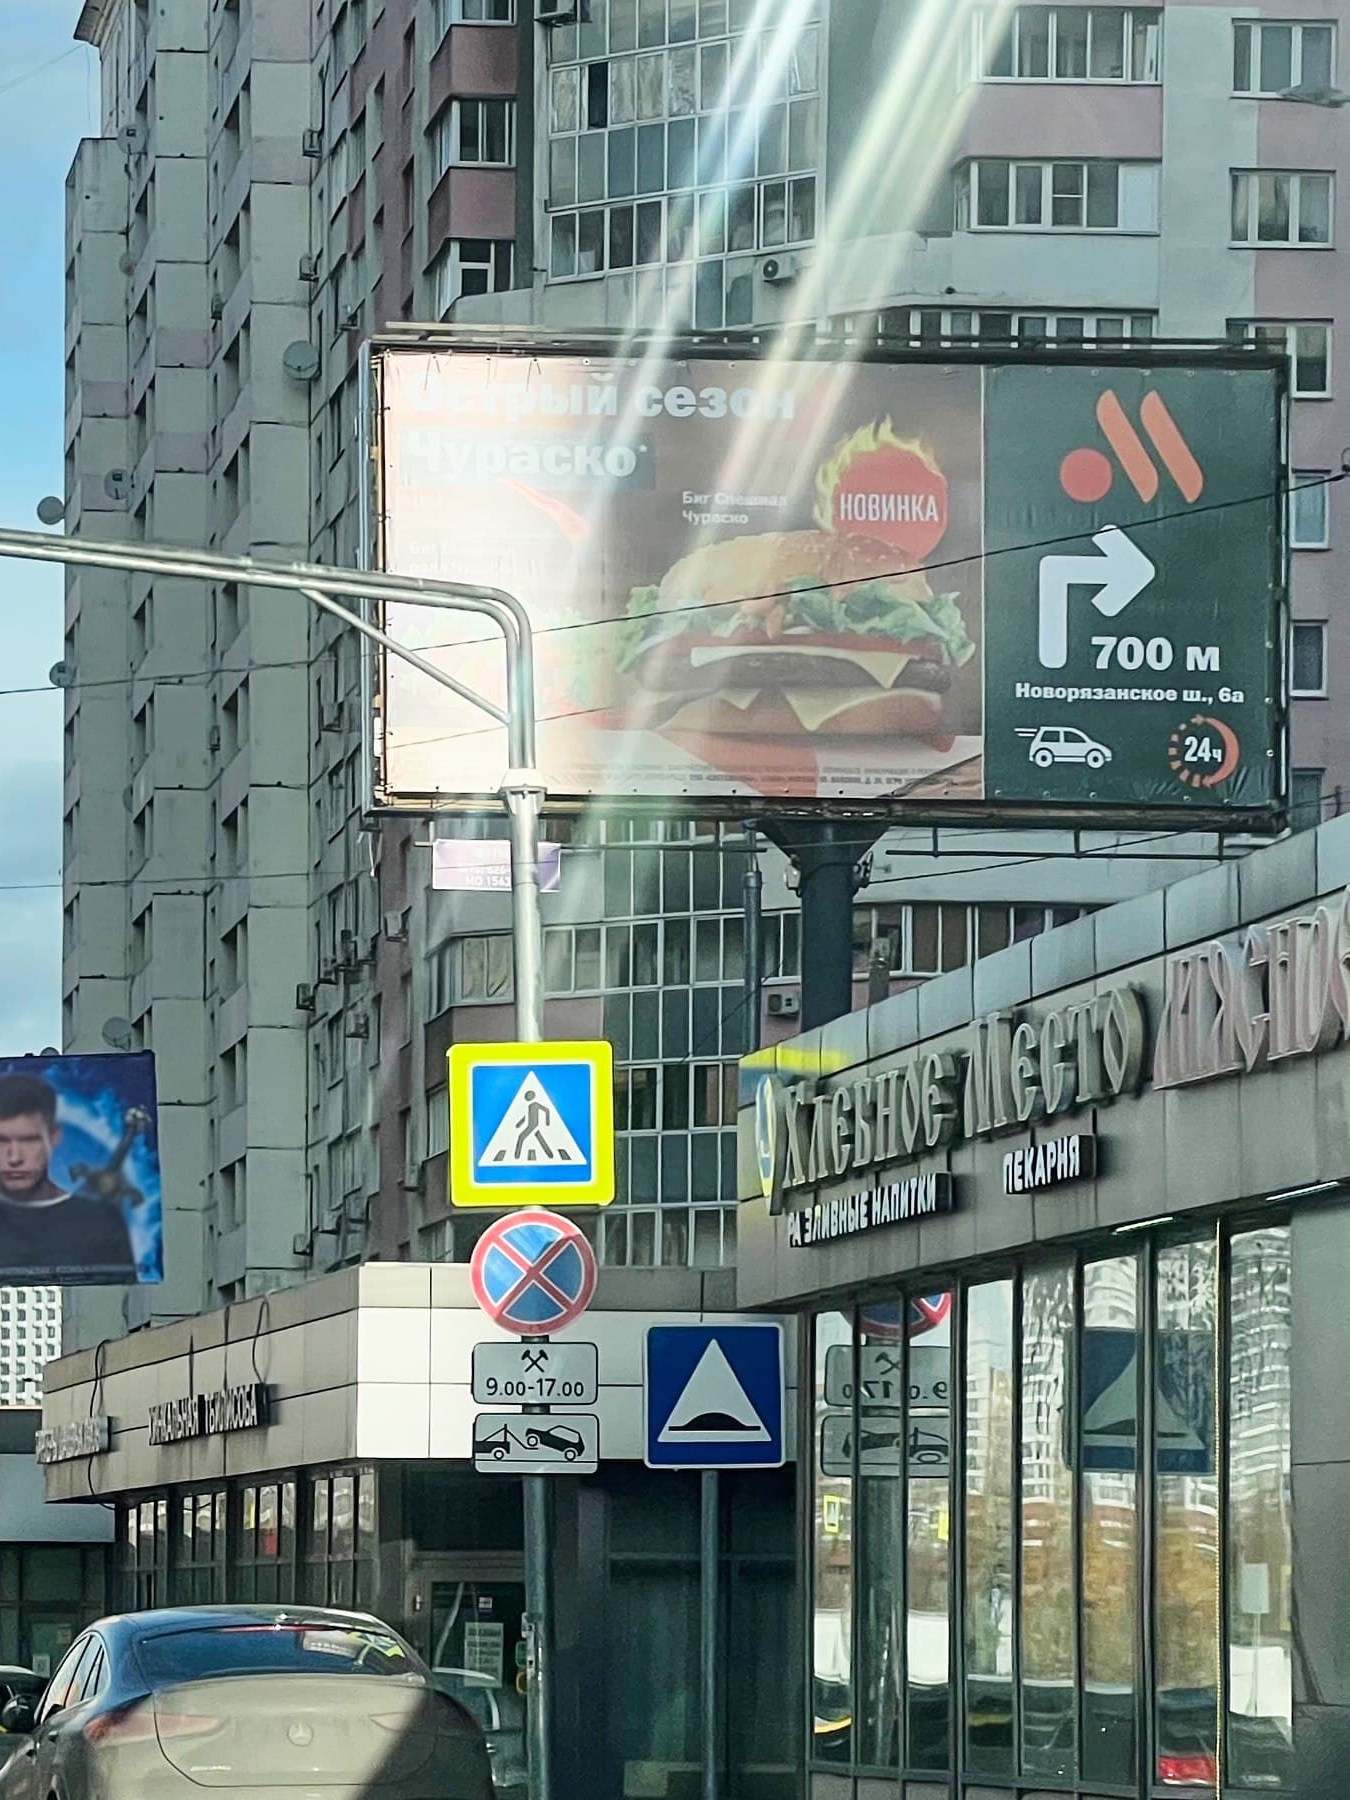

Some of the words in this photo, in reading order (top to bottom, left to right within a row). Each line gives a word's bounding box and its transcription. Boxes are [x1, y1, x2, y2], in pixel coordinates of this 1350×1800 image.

[408, 371, 619, 423] Острый
[634, 383, 796, 419] сезон
[682, 491, 710, 505] Биг
[839, 493, 940, 523] НОВИНКА
[682, 510, 749, 526] Чураско
[1090, 636, 1174, 671] 700
[1186, 646, 1220, 672] м
[1014, 682, 1177, 703] Новорязанское
[1218, 687, 1245, 704] 6а
[1183, 736, 1222, 763] 24ч
[1003, 1134, 1081, 1194] ПЕКАРНЯ
[871, 1173, 936, 1227] НАПИТКИ
[485, 1376, 585, 1398] 9.00-17.00
